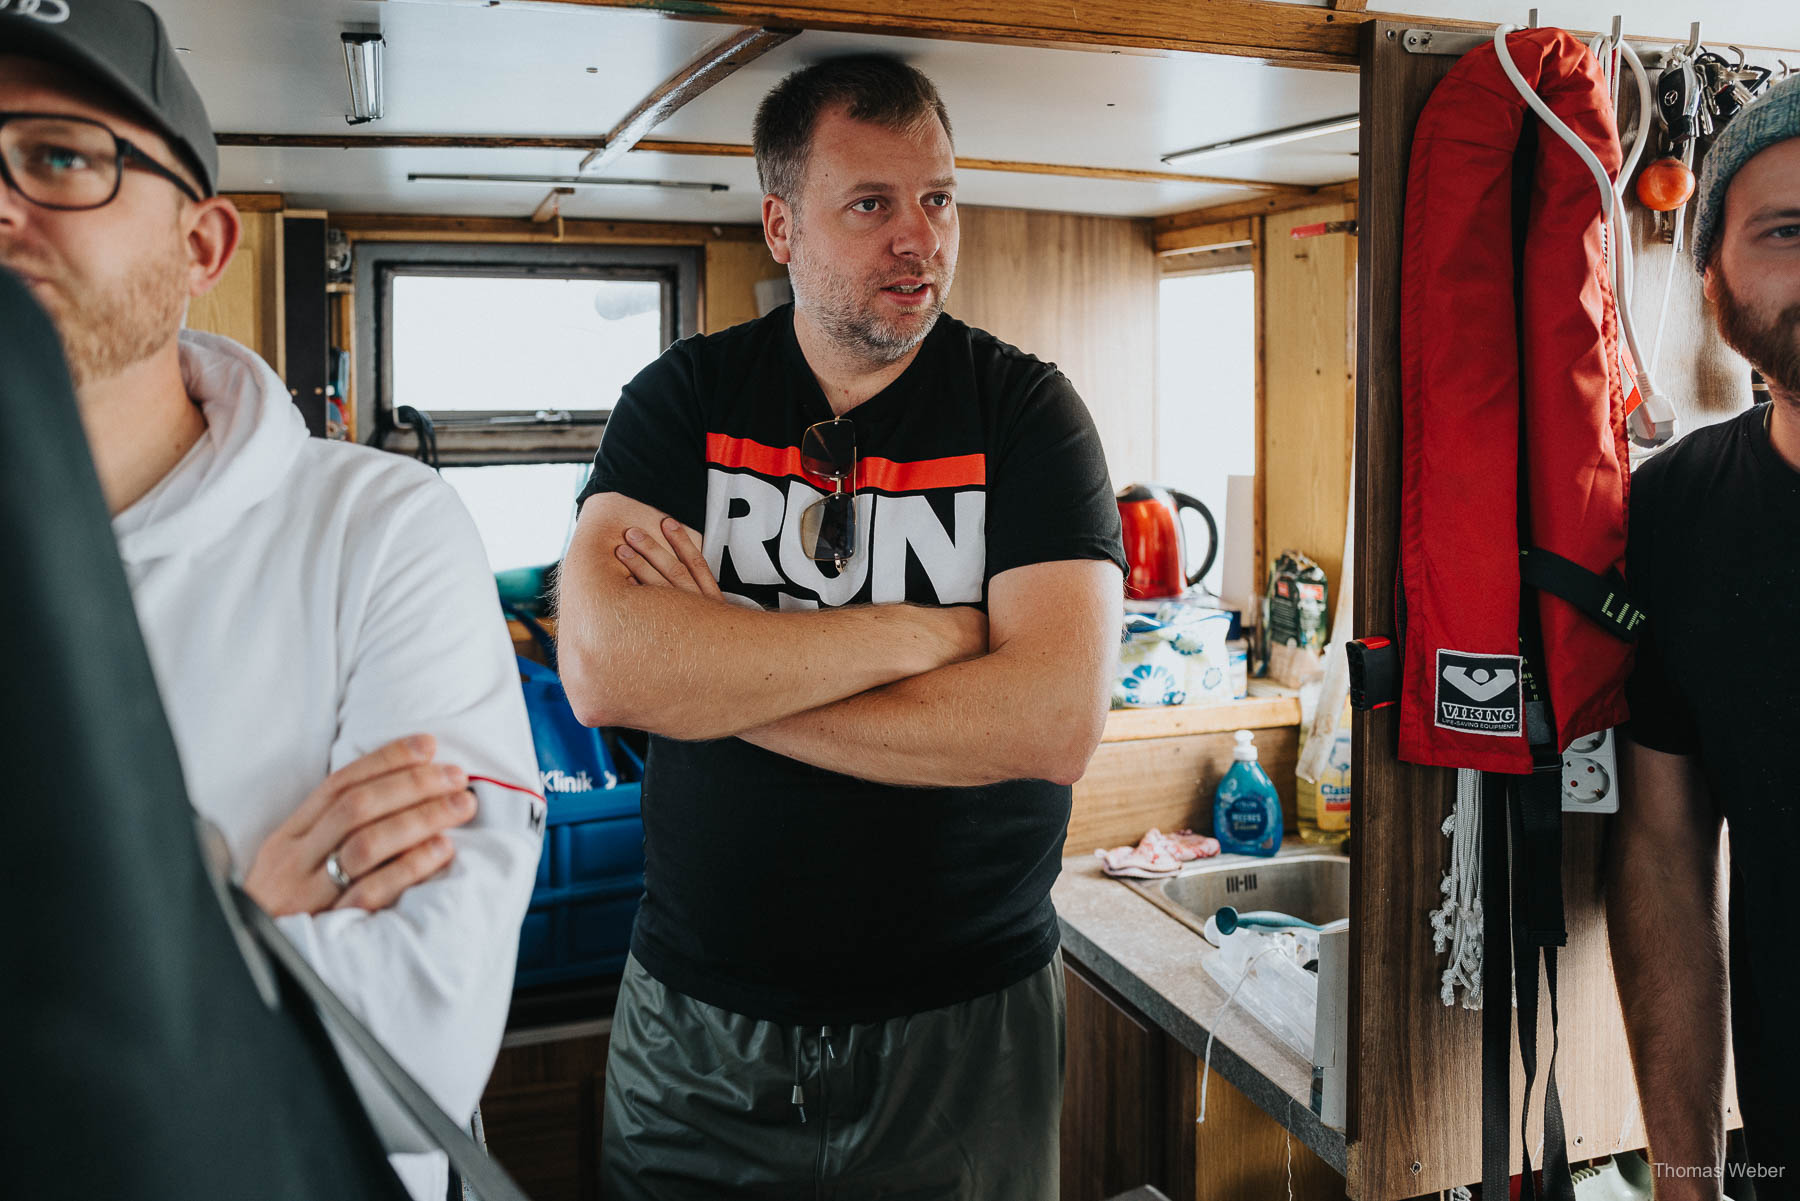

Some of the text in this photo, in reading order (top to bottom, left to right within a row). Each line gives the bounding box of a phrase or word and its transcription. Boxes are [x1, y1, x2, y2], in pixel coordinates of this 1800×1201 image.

[702, 468, 986, 606] RUN
[1442, 702, 1515, 723] VIKING
[1442, 718, 1514, 730] LIFE-SAVING EQUIPMENT
[540, 769, 593, 793] Klinik
